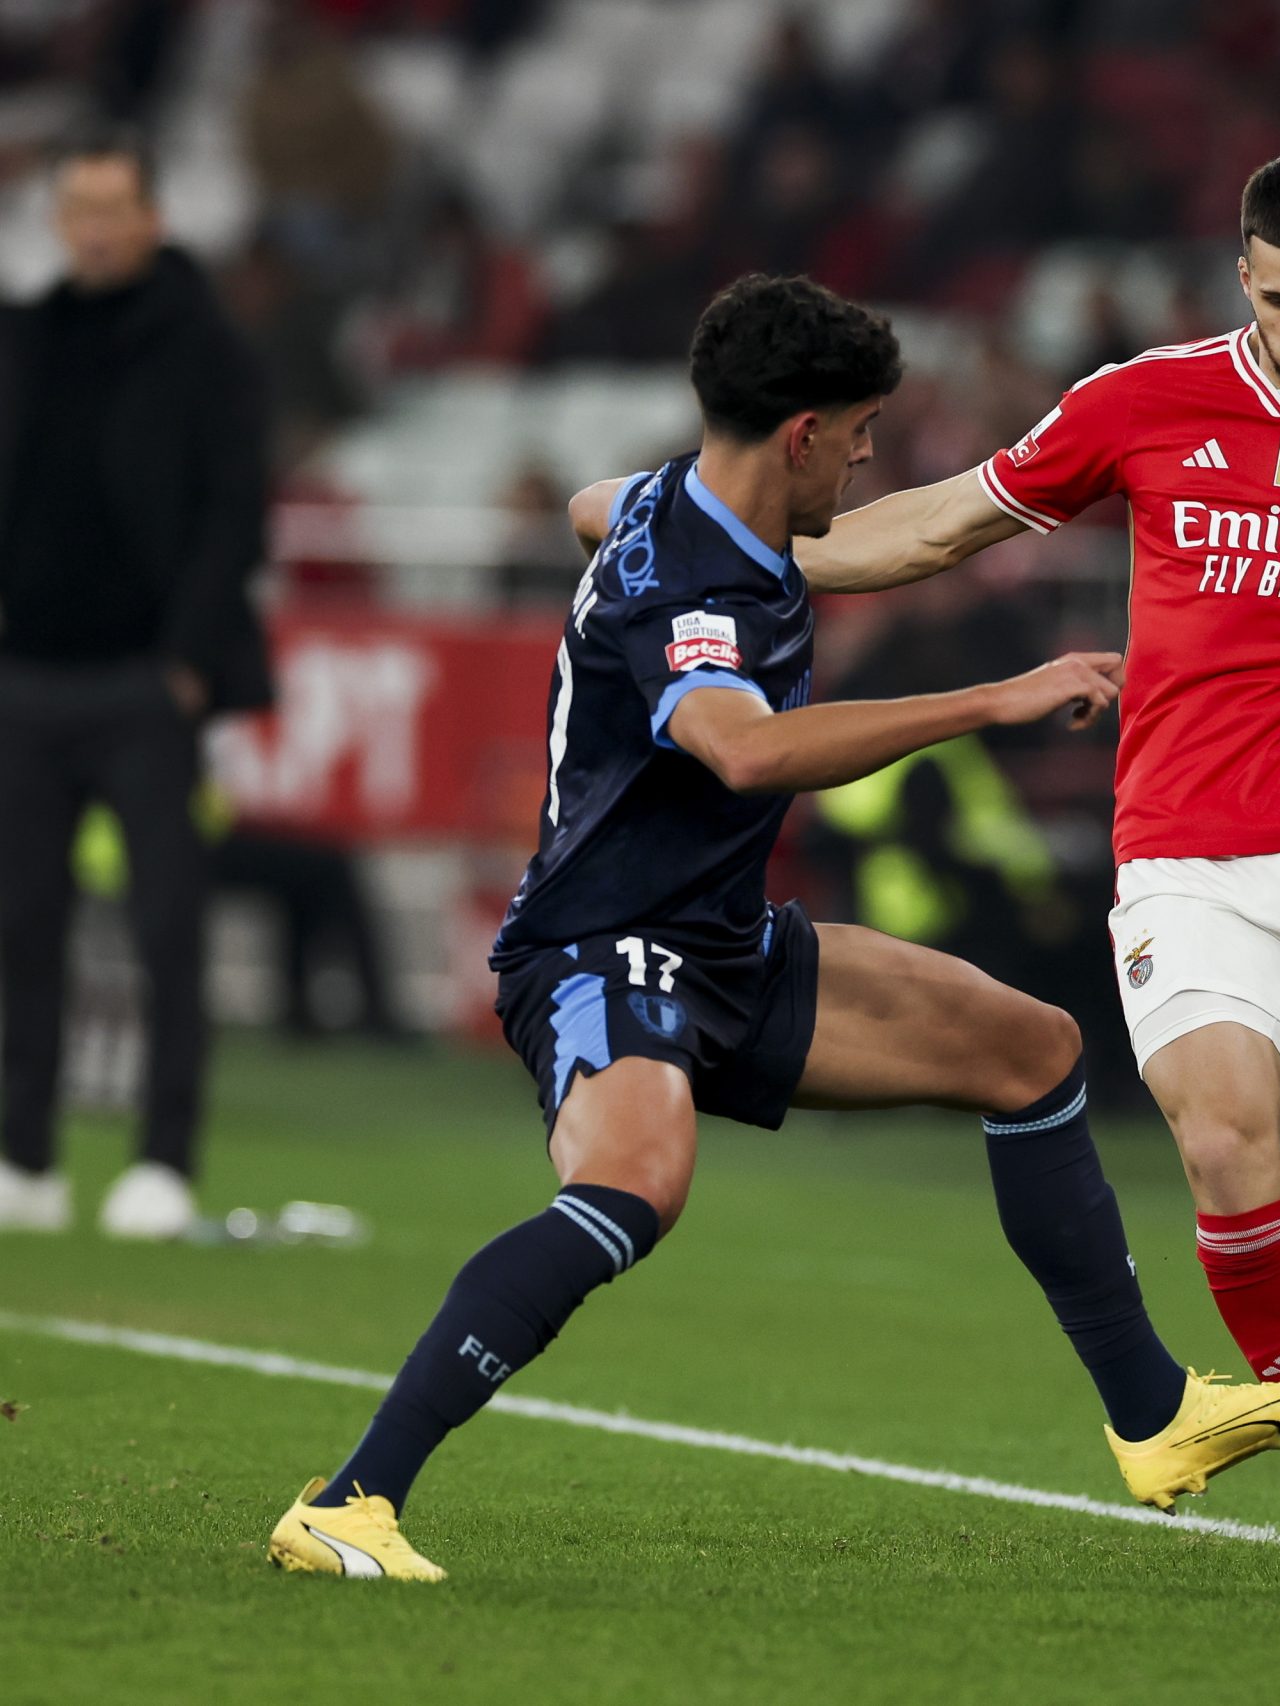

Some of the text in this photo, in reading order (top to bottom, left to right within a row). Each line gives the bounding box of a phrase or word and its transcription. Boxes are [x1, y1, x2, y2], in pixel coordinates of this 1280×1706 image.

[1199, 555, 1252, 594] FLY
[677, 616, 701, 629] LIGA
[678, 626, 732, 642] PORTUGAL
[673, 640, 740, 664] Betclic
[615, 936, 683, 994] 17
